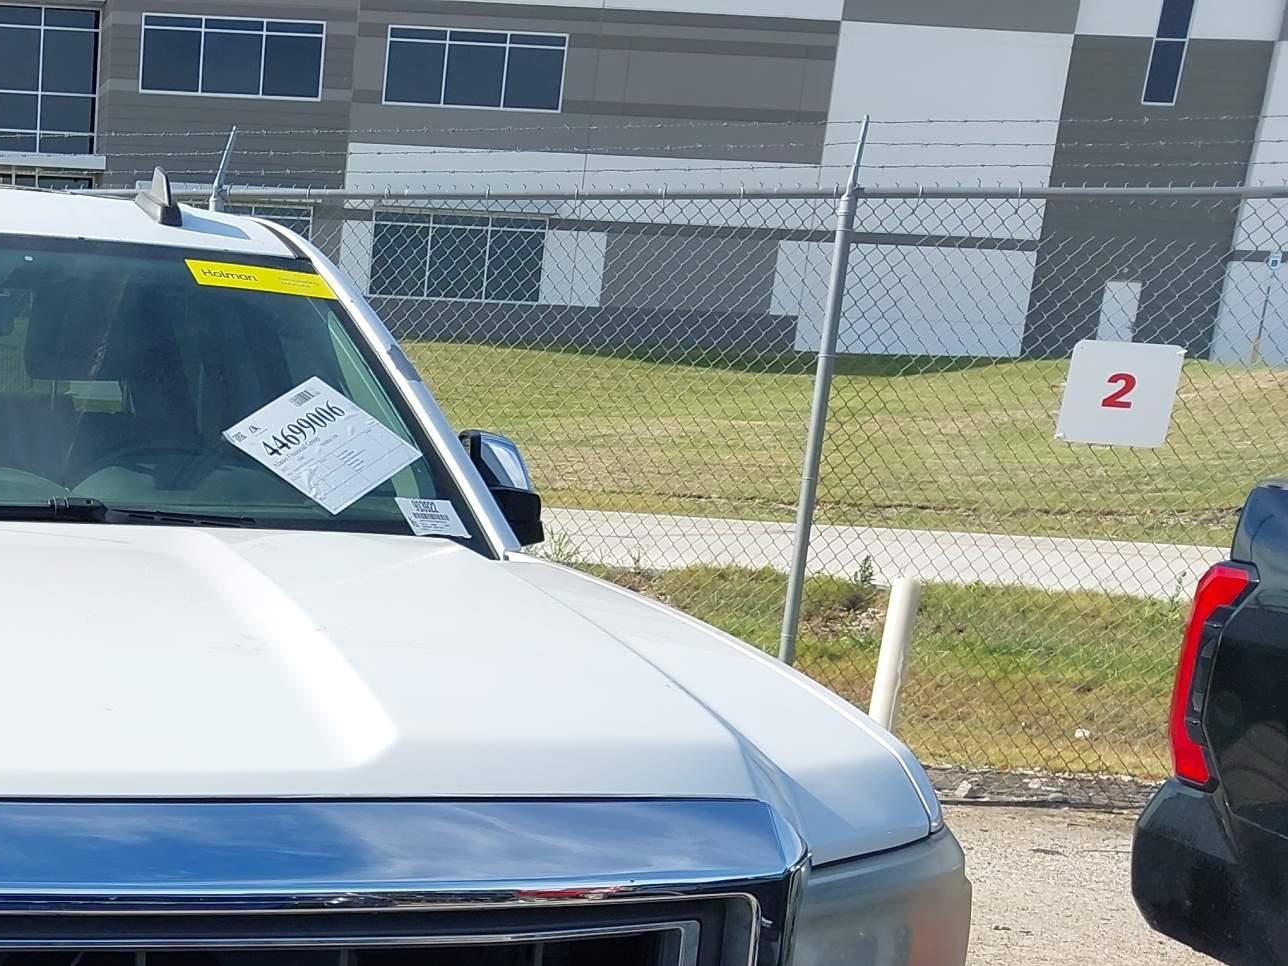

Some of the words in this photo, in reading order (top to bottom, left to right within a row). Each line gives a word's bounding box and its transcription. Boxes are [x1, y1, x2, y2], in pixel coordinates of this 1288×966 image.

[201, 269, 258, 282] Holman
[1101, 373, 1136, 409] 2
[262, 400, 346, 456] 44699006
